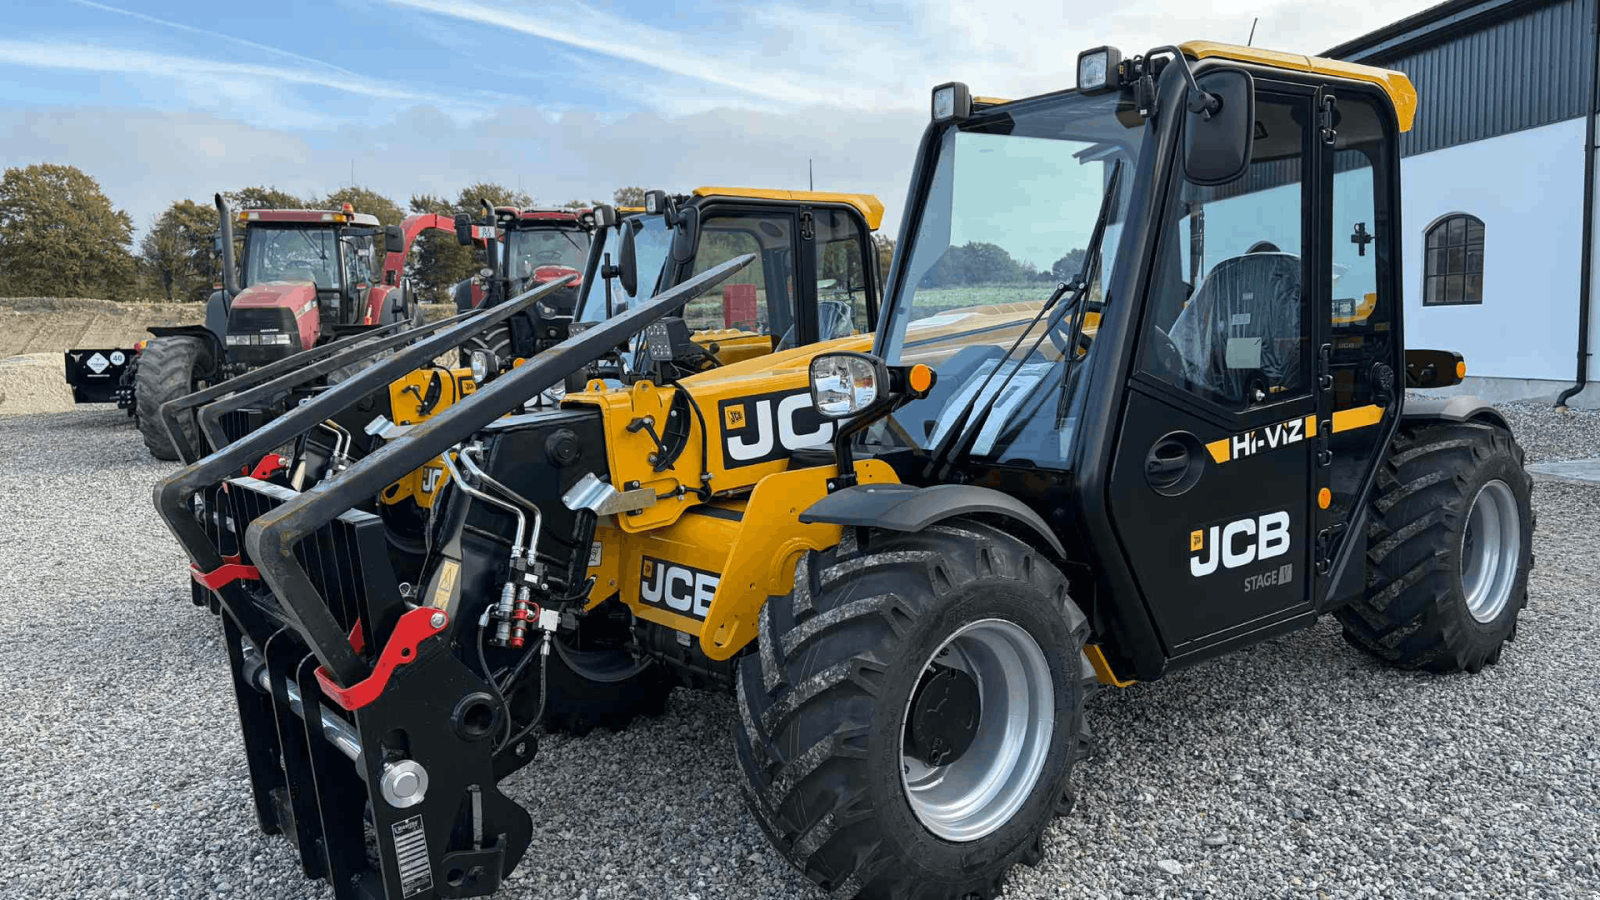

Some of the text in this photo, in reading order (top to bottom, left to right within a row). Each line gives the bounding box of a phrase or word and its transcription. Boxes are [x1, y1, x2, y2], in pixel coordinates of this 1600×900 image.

[112, 354, 123, 362] 40
[727, 392, 852, 461] JC
[1190, 510, 1290, 578] JCB
[1244, 570, 1278, 592] STAGE
